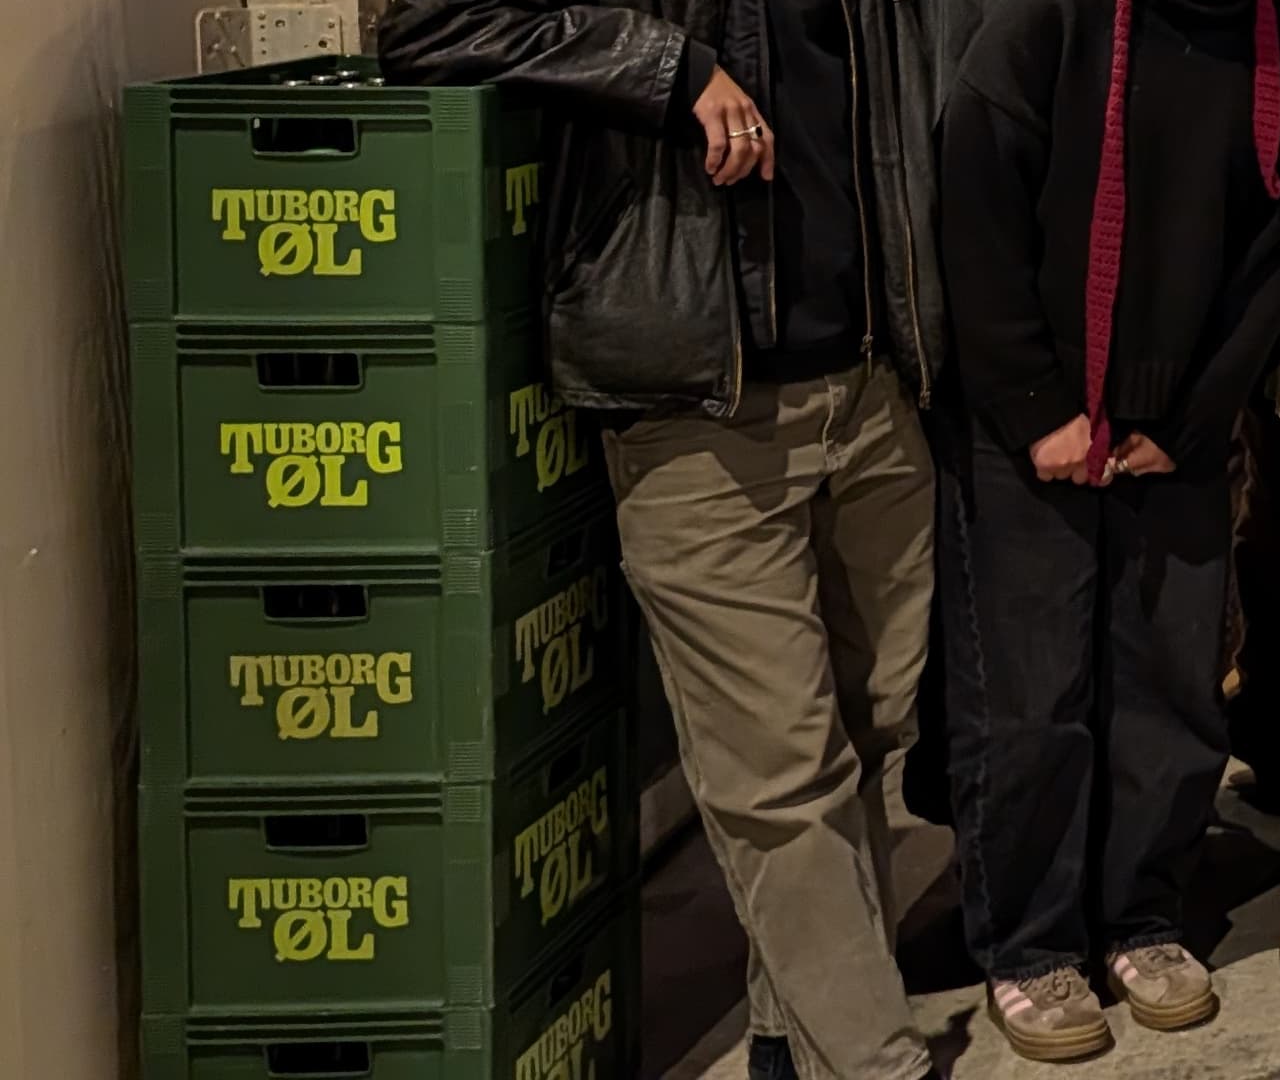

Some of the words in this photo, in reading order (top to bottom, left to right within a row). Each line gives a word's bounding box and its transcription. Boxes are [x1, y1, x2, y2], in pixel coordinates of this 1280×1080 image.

[212, 188, 397, 242] TUBORG
[258, 222, 362, 276] ØL
[220, 421, 403, 474] TUBORG
[536, 409, 589, 493] ØL
[266, 454, 368, 508] ØL
[230, 652, 413, 706] TUBORG
[540, 622, 594, 715] ØL
[276, 686, 378, 740] ØL
[514, 767, 608, 899] TUBORG
[229, 876, 409, 927] TUBORG
[540, 832, 592, 926] ØL
[273, 910, 375, 962] ØL
